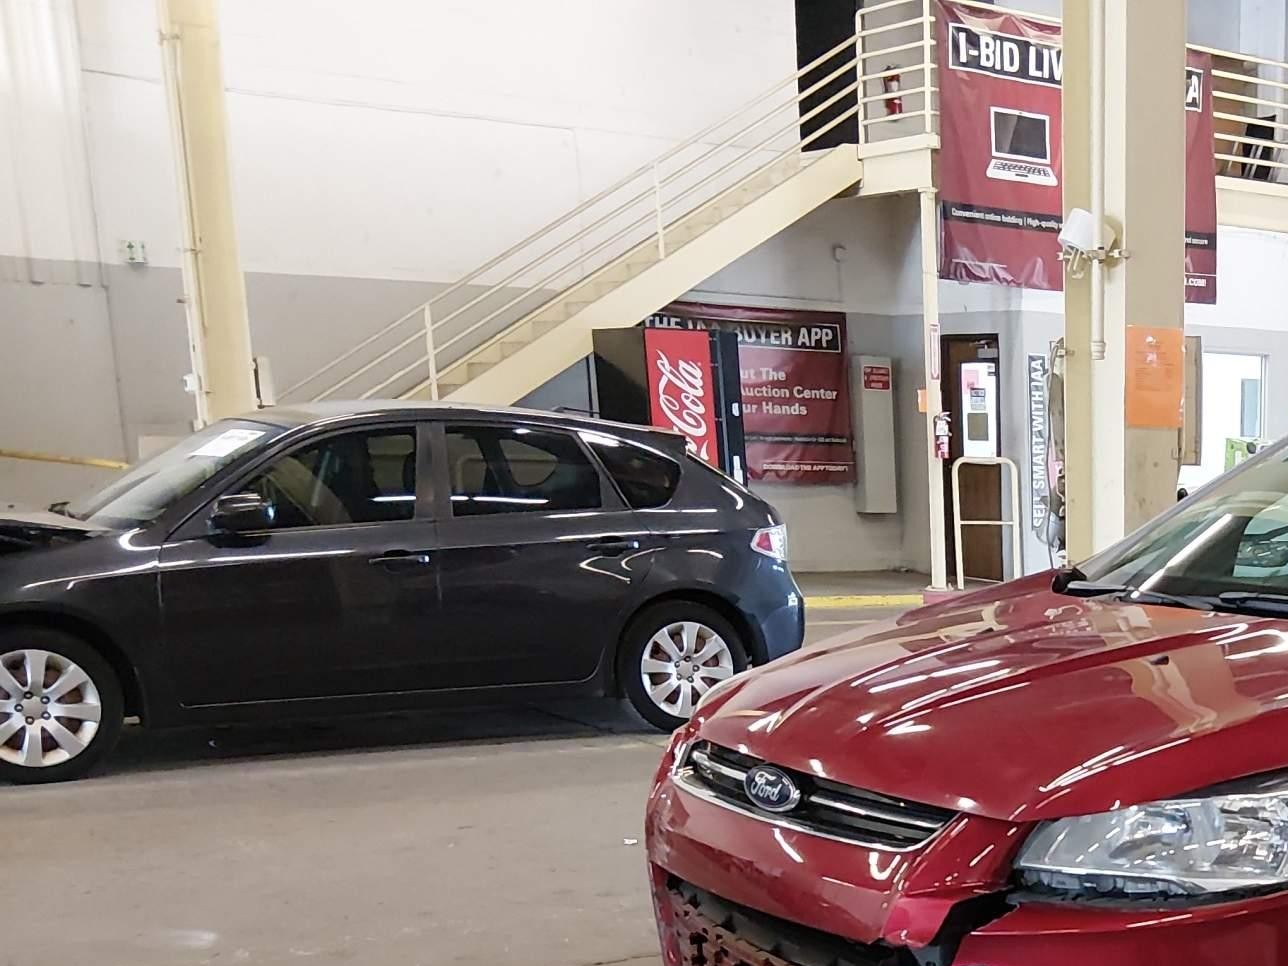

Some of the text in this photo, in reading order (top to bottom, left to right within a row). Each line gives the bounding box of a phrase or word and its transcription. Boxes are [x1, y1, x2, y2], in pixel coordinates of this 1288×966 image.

[958, 31, 1063, 81] I-BID LIV
[797, 326, 833, 348] APP
[740, 367, 786, 381] ut The
[657, 349, 707, 438] Cola
[743, 401, 808, 415] ur Hands
[793, 386, 838, 400] Center
[1031, 389, 1044, 432] WITH
[1032, 436, 1045, 489] SMART
[750, 770, 783, 802] Ford
